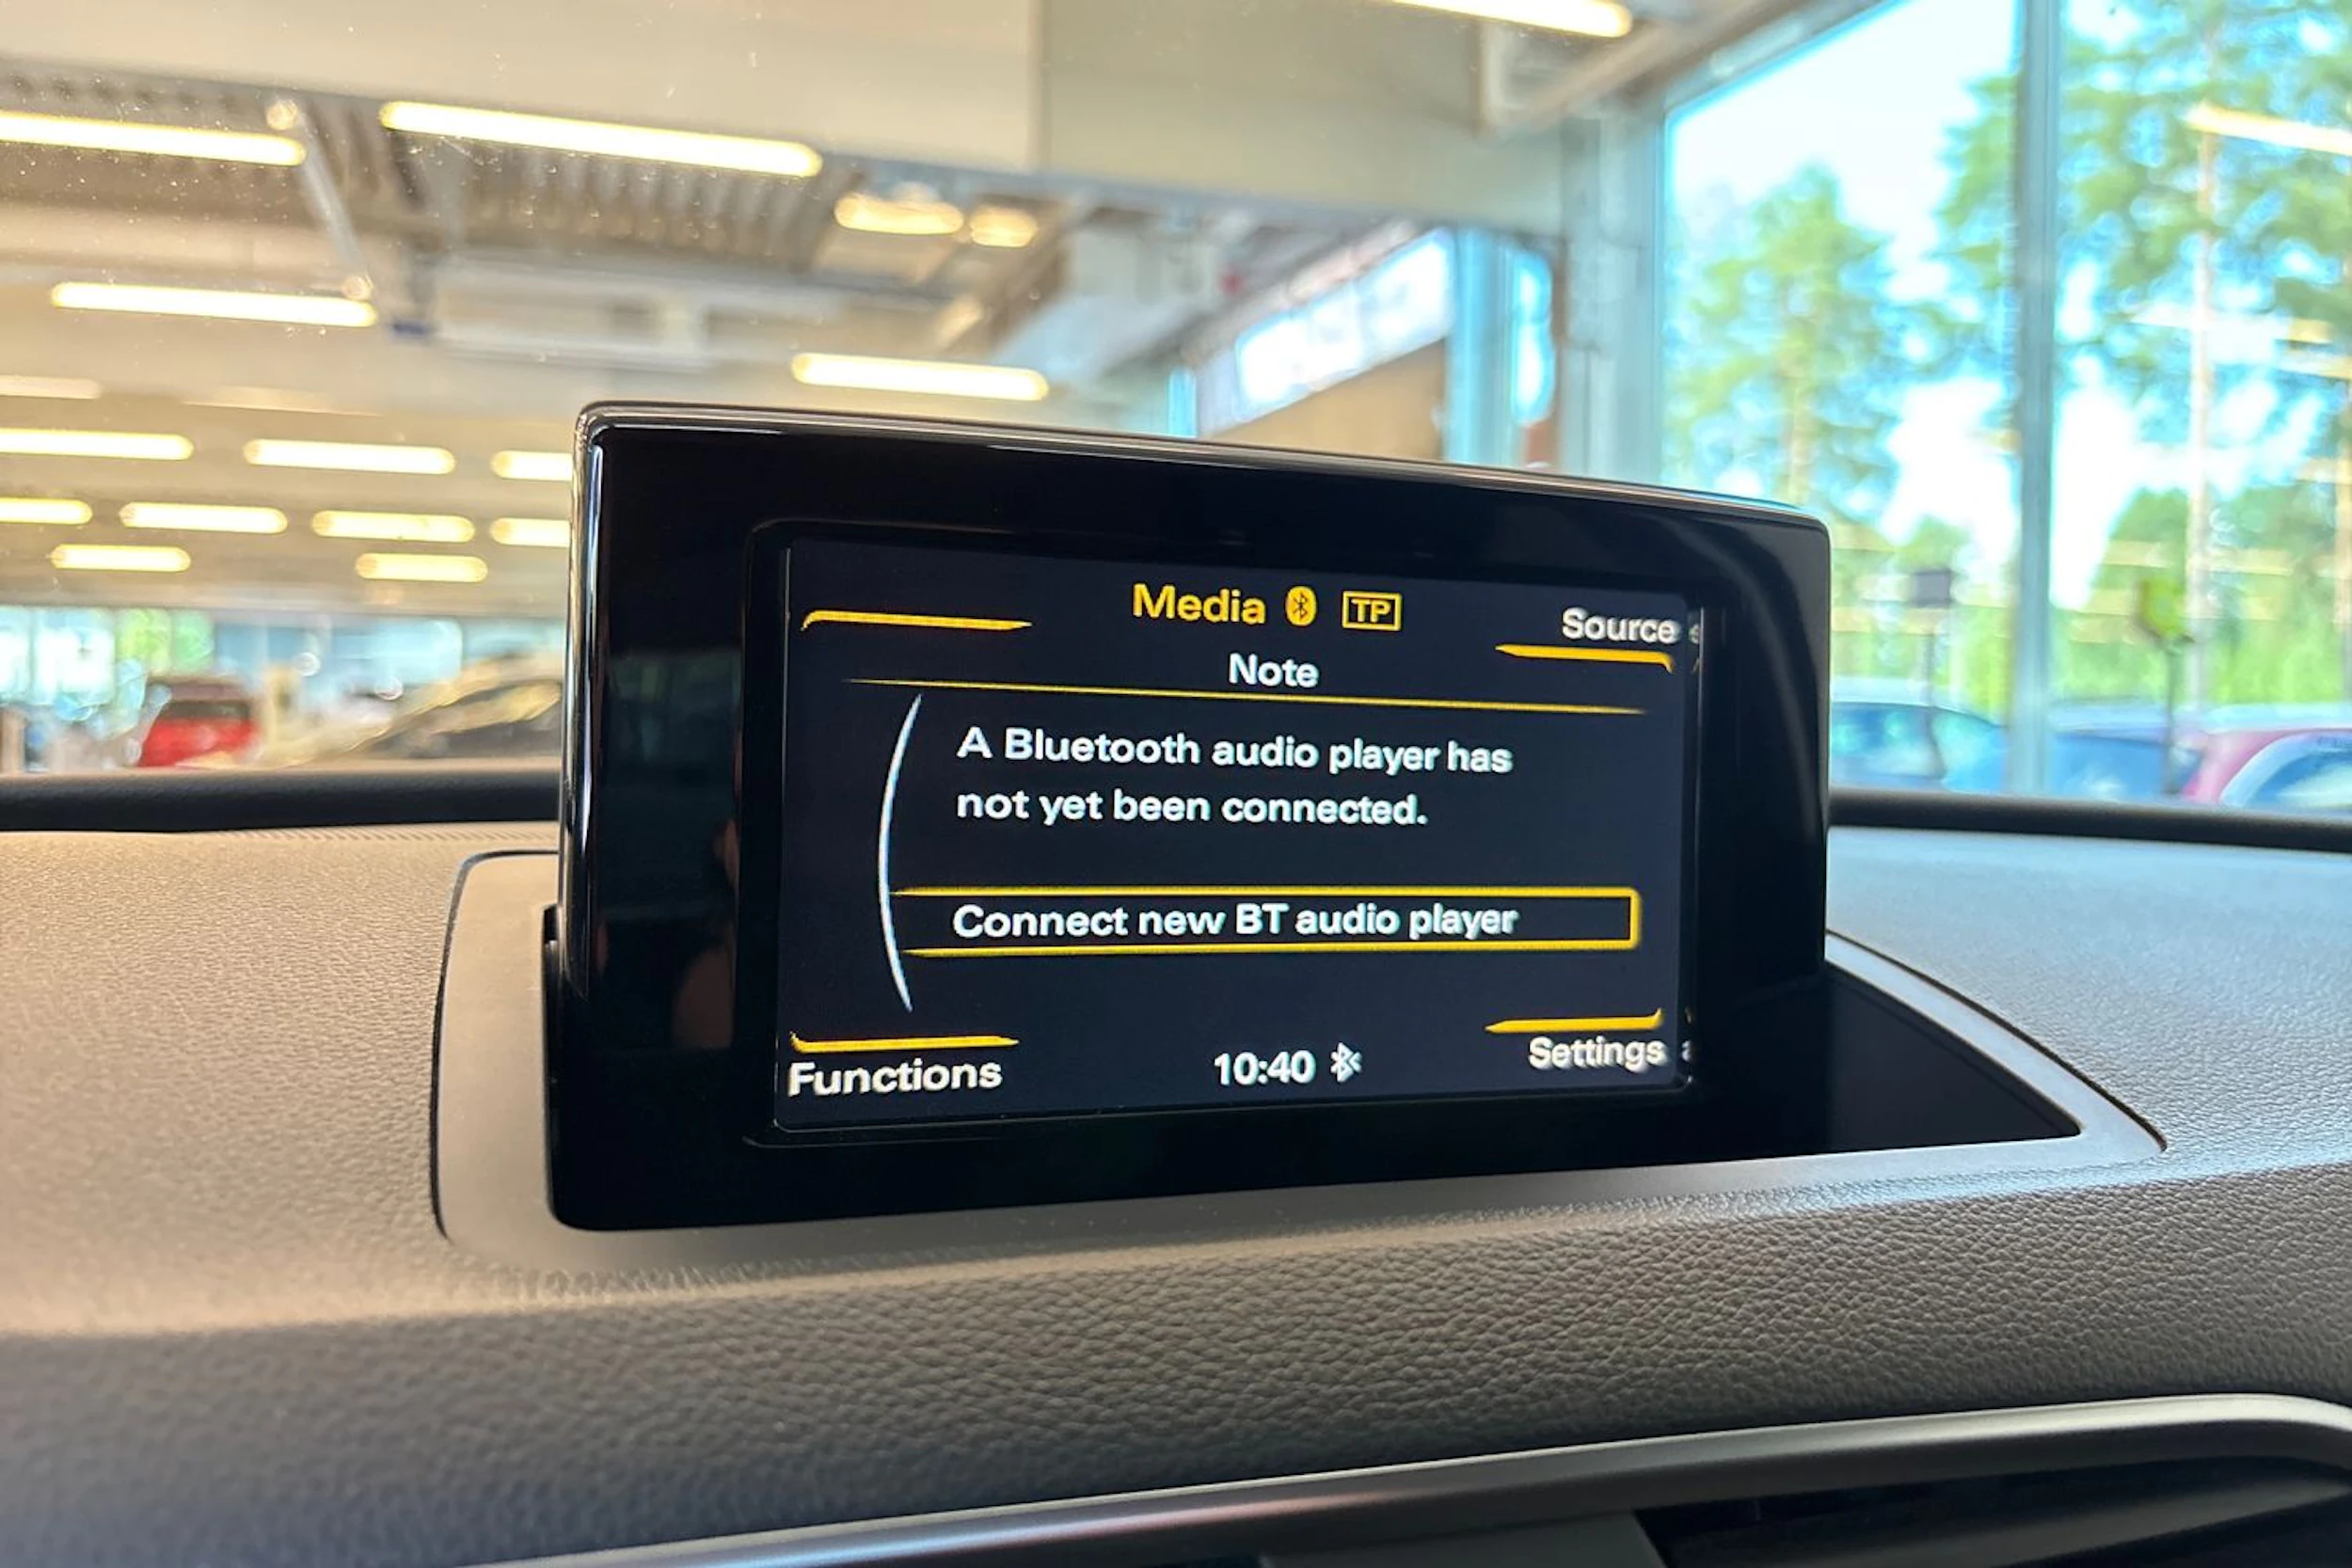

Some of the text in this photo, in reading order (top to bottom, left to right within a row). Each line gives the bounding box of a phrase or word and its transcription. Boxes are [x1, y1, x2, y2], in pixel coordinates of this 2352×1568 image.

[1133, 583, 1265, 625] Media
[1351, 598, 1391, 623] TP
[1561, 607, 1679, 644] Source
[1229, 653, 1319, 689] Note
[956, 726, 1513, 776] A Bluetooth audio player has
[957, 787, 1428, 826] not yet been connected.
[952, 902, 1519, 941] Connect new BT audio player
[1214, 1050, 1316, 1085] 10:40
[1528, 1036, 1668, 1073] Settings
[788, 1057, 1003, 1097] Functions
